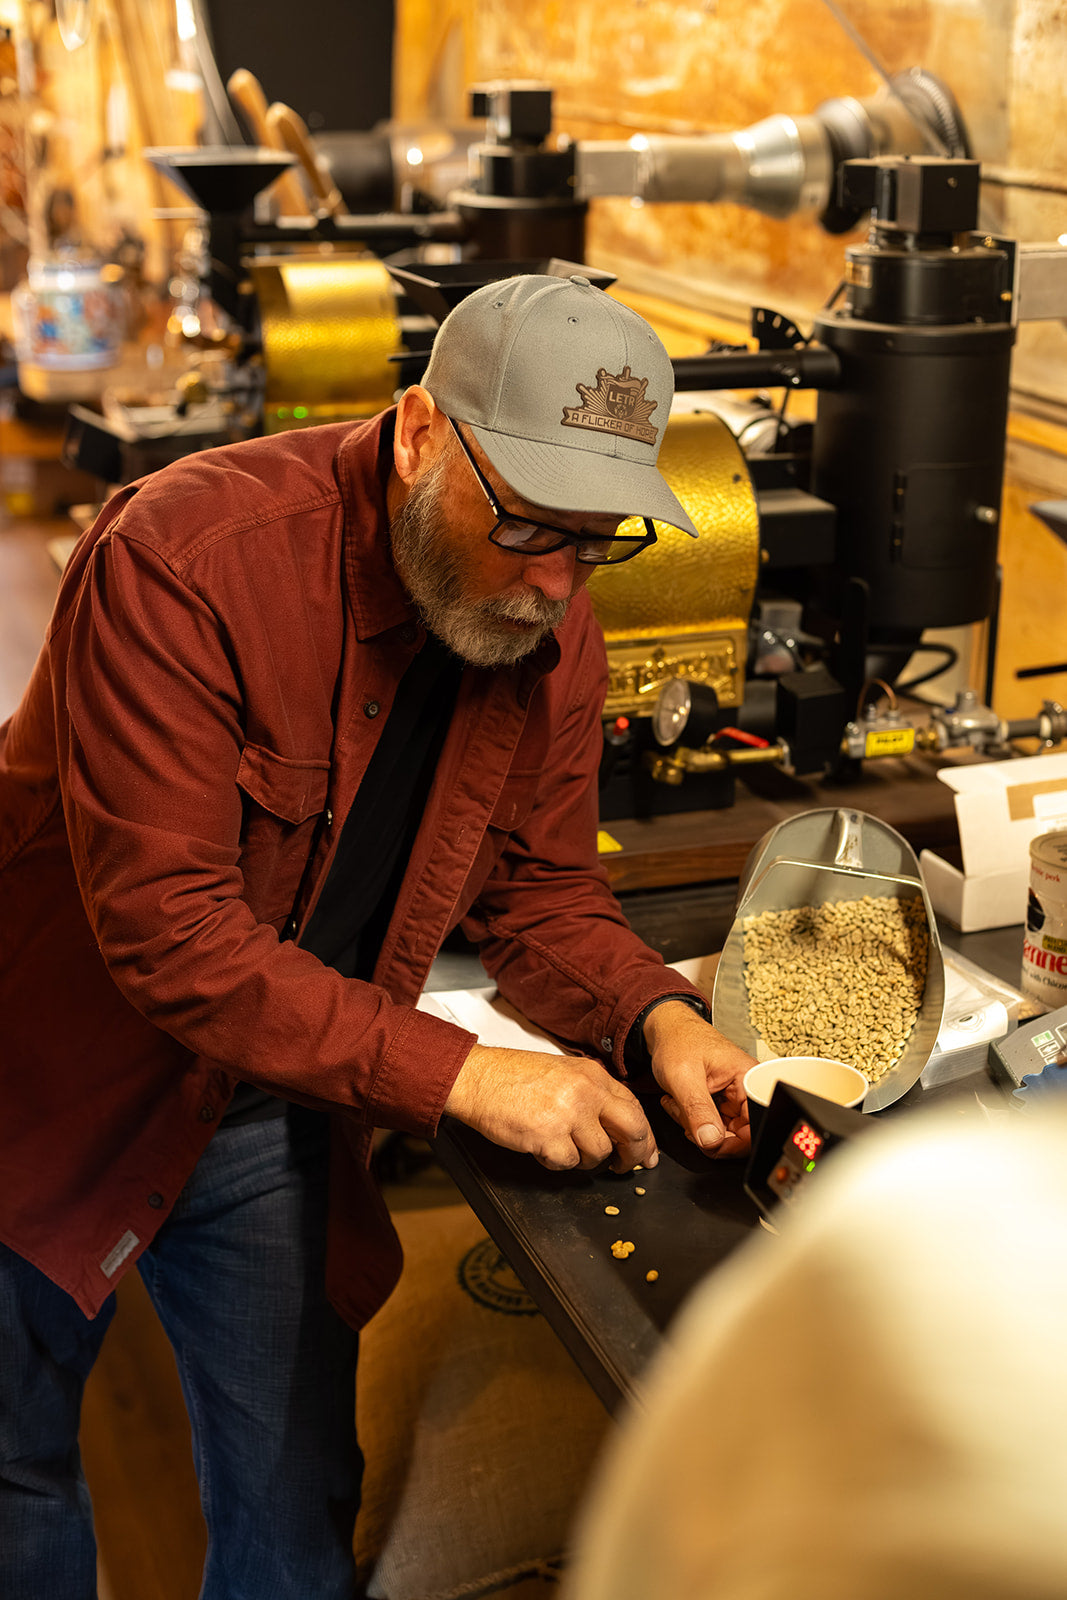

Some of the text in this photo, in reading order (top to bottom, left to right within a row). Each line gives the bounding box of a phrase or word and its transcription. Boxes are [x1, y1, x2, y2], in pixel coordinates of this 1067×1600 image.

[609, 391, 635, 406] LETR
[571, 412, 655, 439] A FLICKER OF HOPE
